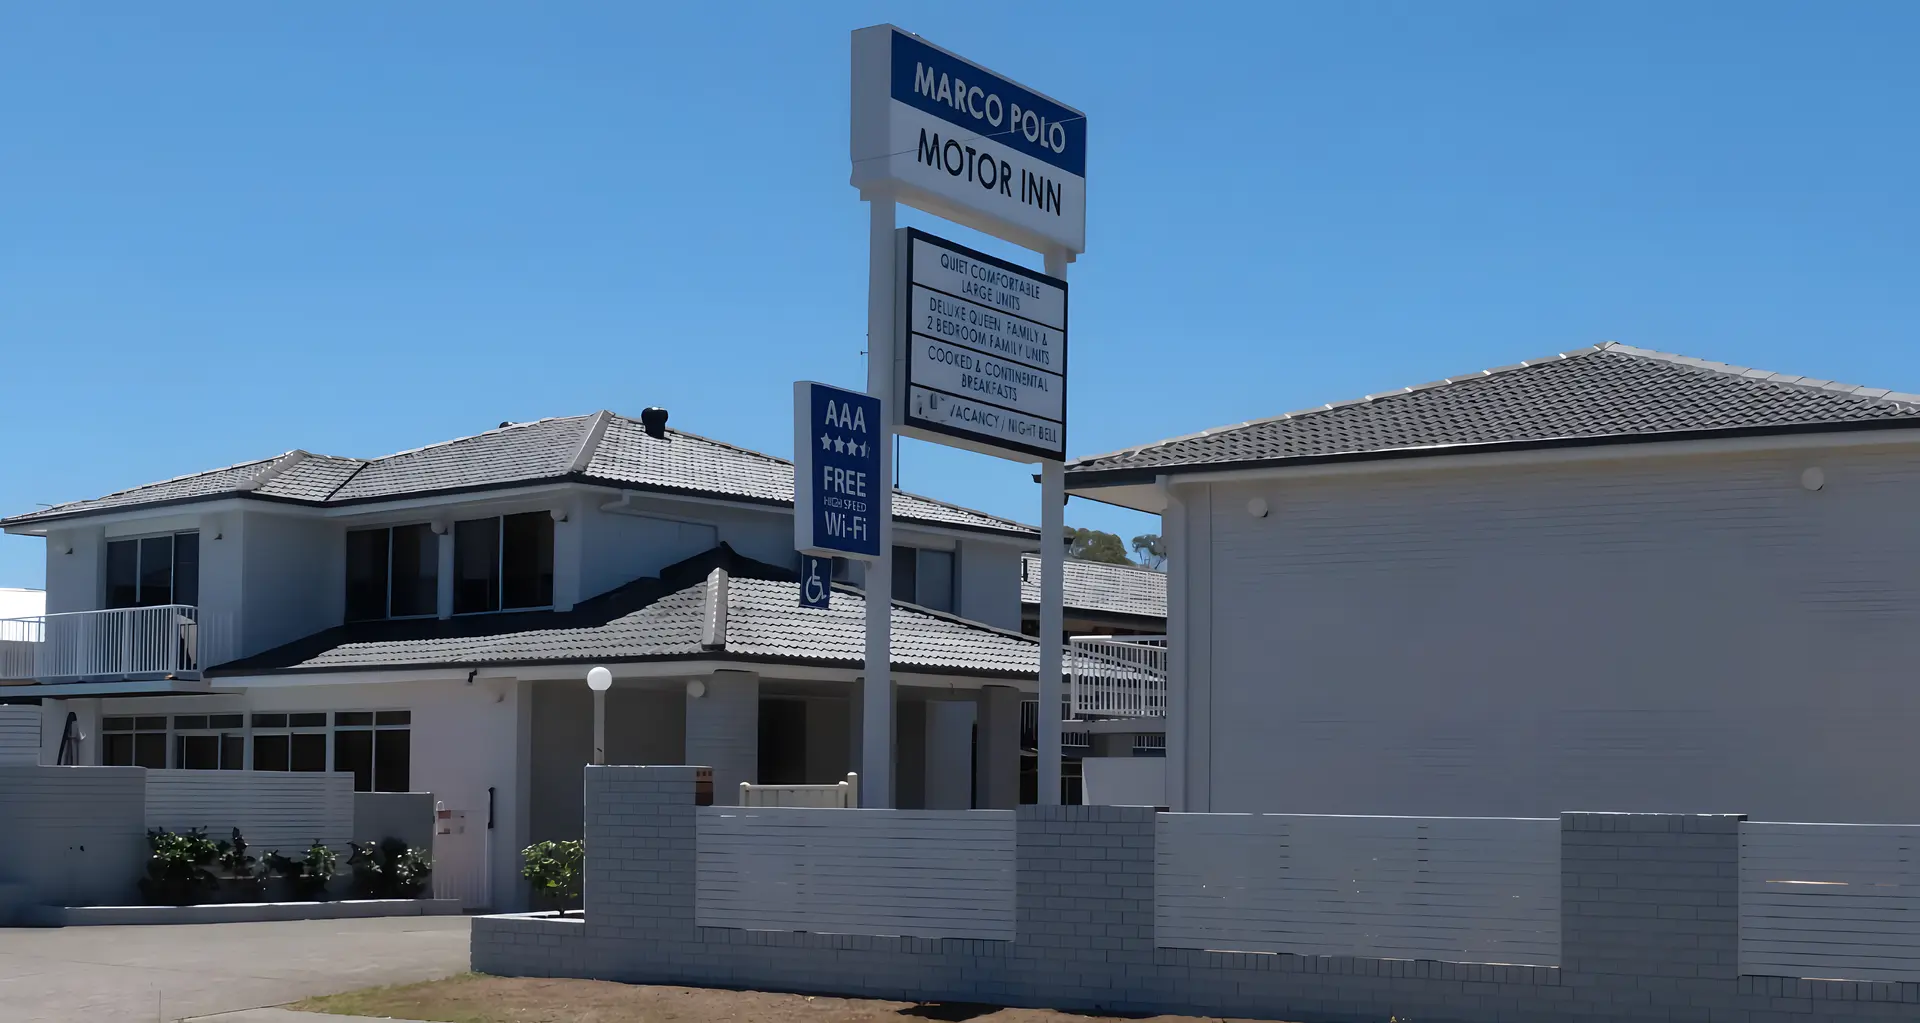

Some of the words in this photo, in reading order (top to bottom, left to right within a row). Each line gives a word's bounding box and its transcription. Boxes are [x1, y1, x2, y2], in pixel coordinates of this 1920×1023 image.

[914, 62, 1003, 127] MARCO
[1010, 103, 1066, 154] POLO
[917, 128, 1012, 197] MOTOR
[1021, 168, 1061, 217] INN
[940, 253, 968, 276] QUIET
[970, 264, 1040, 300] COMFORTABLE
[961, 280, 993, 302] LARGE
[996, 291, 1021, 311] UNITS
[929, 297, 966, 322] DELUXE
[1006, 321, 1040, 343] FAMILY
[926, 316, 933, 330] 2
[936, 318, 986, 345] BEDROOM
[989, 334, 1023, 357] FAMILY
[1025, 345, 1050, 366] UNITS
[928, 345, 973, 370] COOKED
[975, 360, 981, 373] &
[984, 362, 1049, 393] CONTINENTAL
[961, 373, 1018, 402] BREAKFASTS
[824, 399, 867, 434] AAA
[1008, 418, 1036, 437] NIGHT
[1038, 427, 1057, 444] BELL
[823, 465, 867, 498] FREE
[824, 510, 867, 542] Wi-Fi
